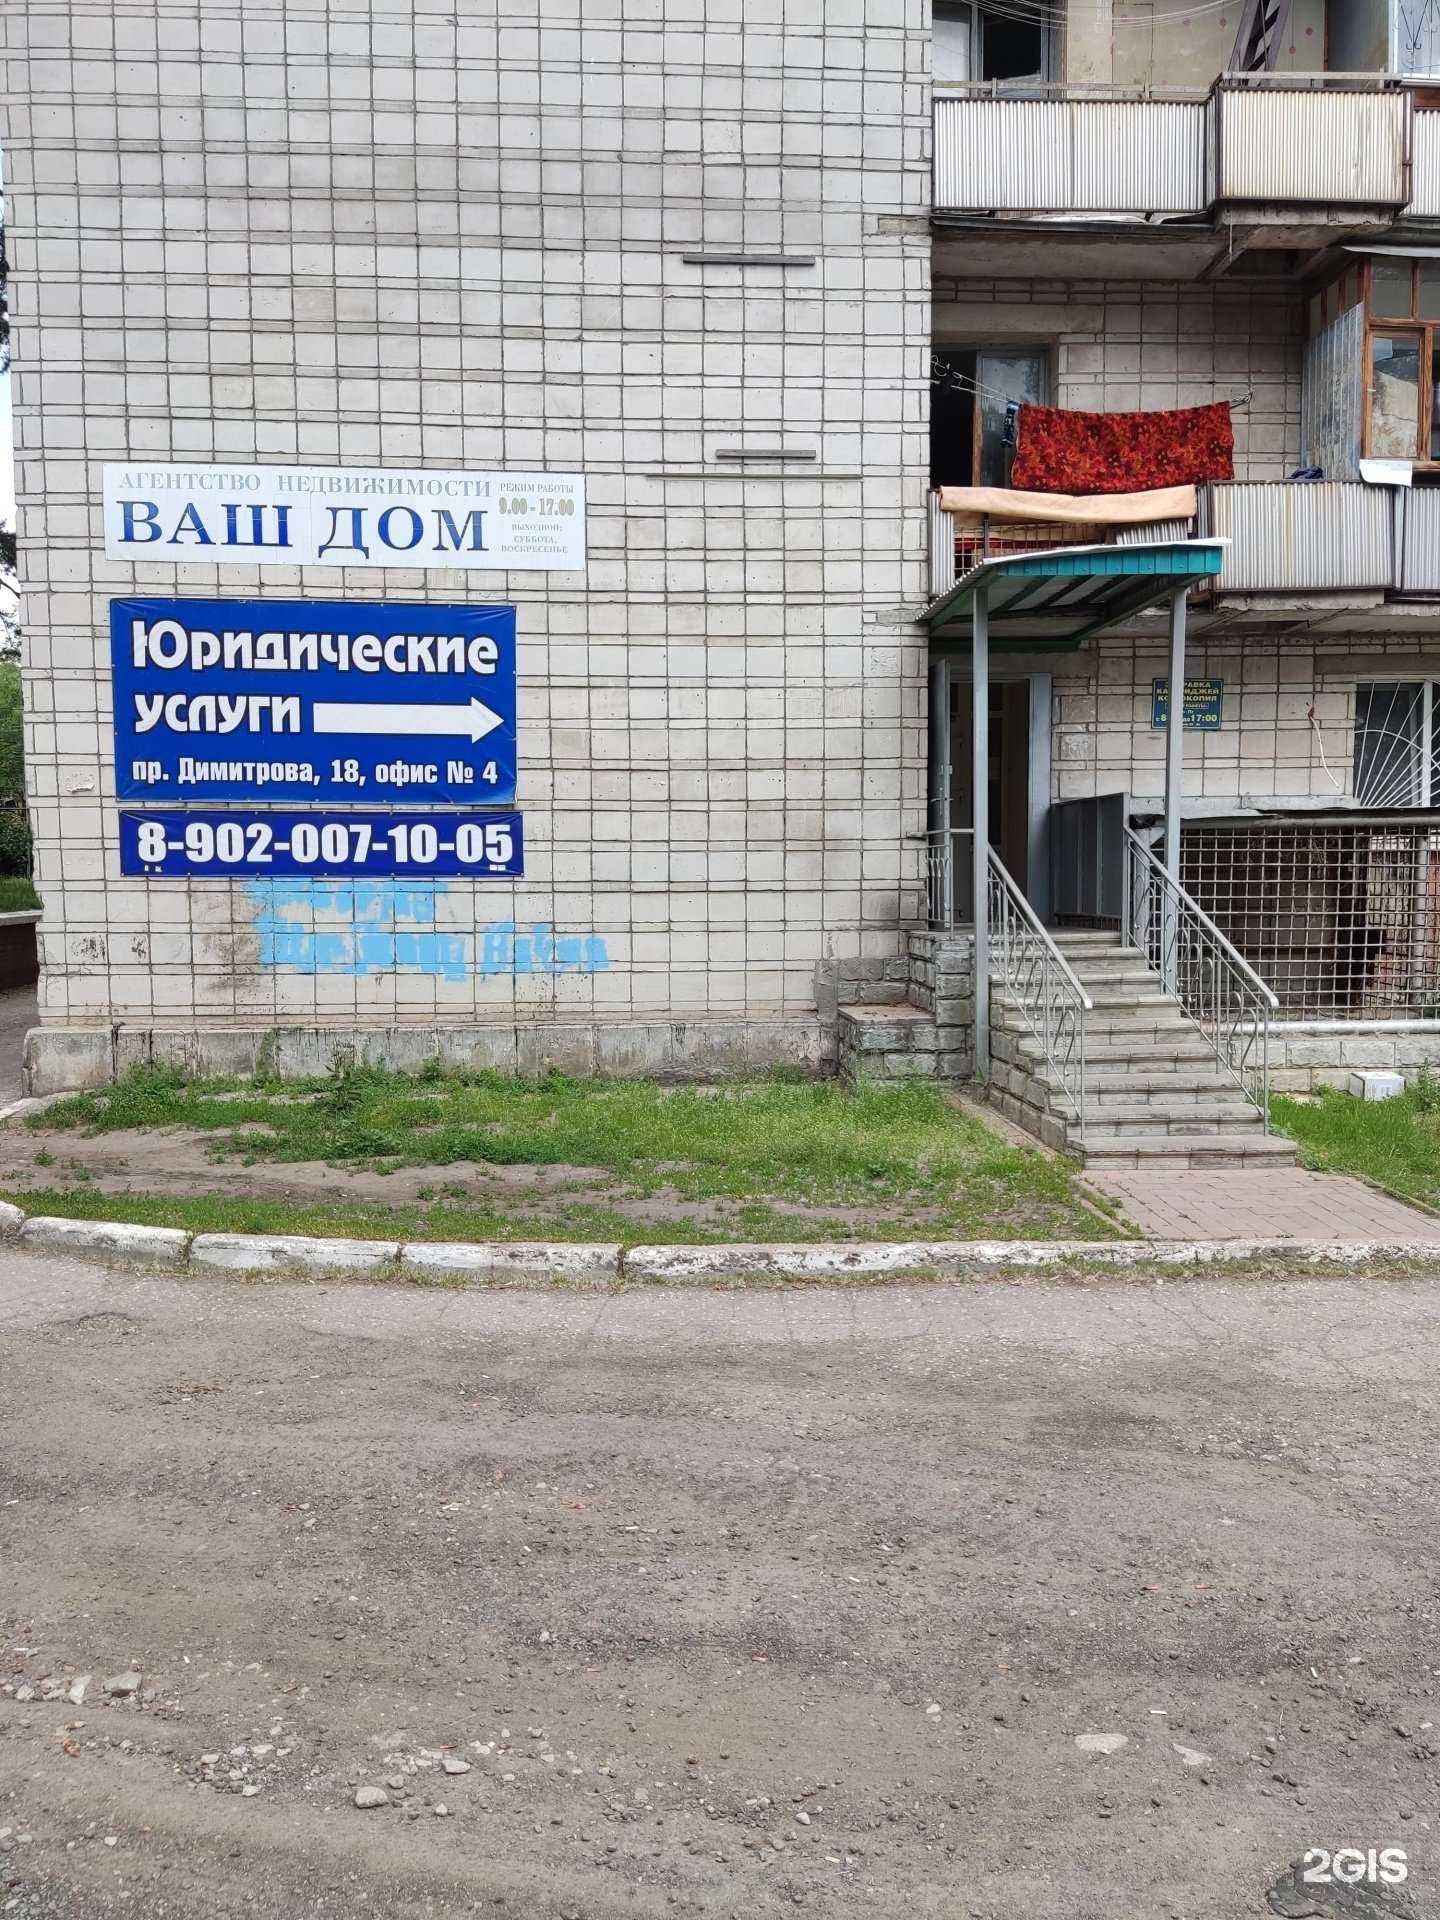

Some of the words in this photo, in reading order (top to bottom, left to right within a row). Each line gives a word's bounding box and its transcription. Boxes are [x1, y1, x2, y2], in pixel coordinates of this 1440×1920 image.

[119, 472, 261, 490] АГЕНТСТВО
[278, 475, 492, 497] НЕДВИЖИМОСТИ
[501, 482, 535, 493] РЕЖИМ
[537, 483, 574, 494] РАБОТЫ
[499, 497, 528, 516] 9.00
[539, 498, 575, 516] 17.00
[116, 500, 293, 547] ВАШ
[318, 506, 490, 559] ДОМ
[132, 619, 499, 674] Юридические
[134, 694, 301, 733] услуги
[1191, 714, 1218, 722] 17:00
[132, 761, 169, 784] пр.
[178, 757, 320, 786] Димитрова,
[330, 759, 367, 786] 18,
[375, 760, 438, 787] офис
[447, 761, 474, 784] №
[482, 761, 499, 784] 4
[137, 822, 513, 864] 8-902-007-10-05
